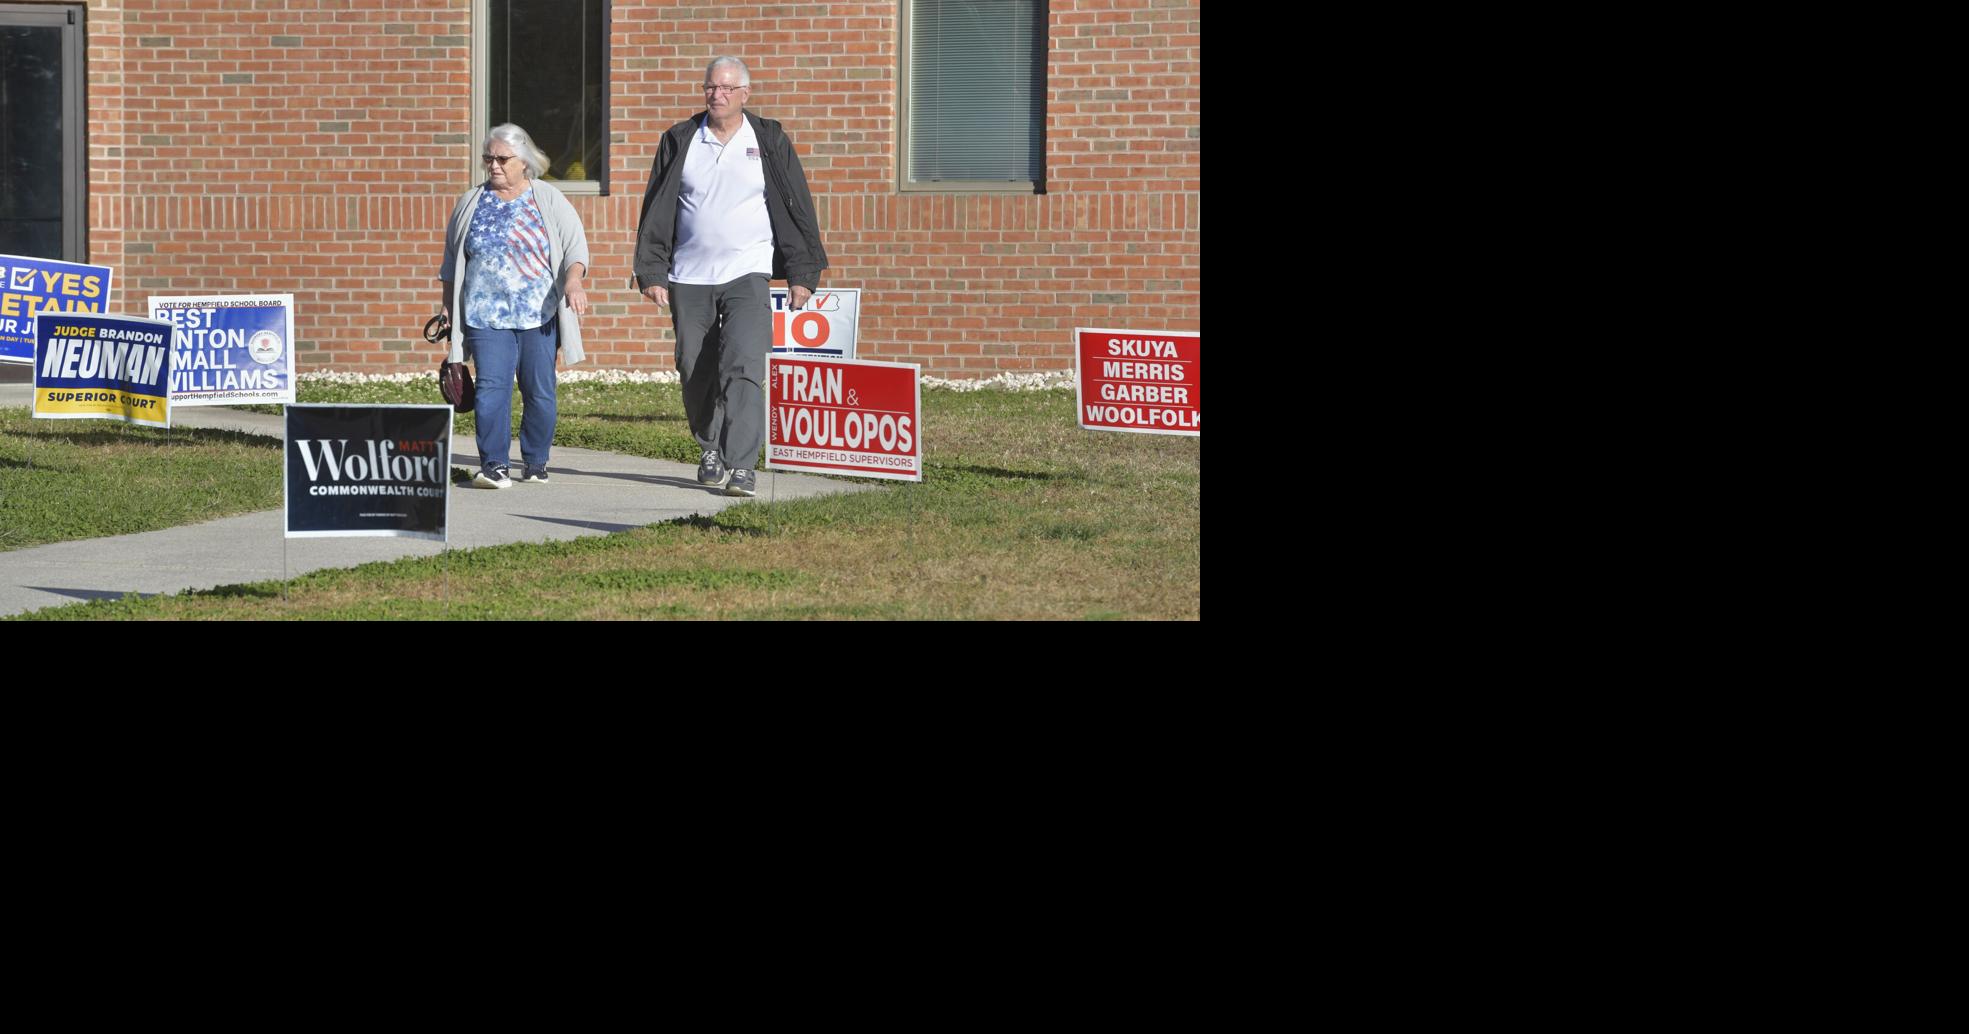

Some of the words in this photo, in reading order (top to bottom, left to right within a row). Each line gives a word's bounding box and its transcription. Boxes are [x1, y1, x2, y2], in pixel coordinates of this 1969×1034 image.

[41, 270, 100, 298] YES
[0, 292, 98, 318] ETAIN
[54, 326, 96, 337] JUDGE
[99, 328, 163, 344] BRANDON
[176, 329, 245, 350] NTON
[1108, 338, 1178, 358] SKUYA
[41, 338, 166, 386] NEUMAN
[171, 349, 237, 370] MALL
[1103, 361, 1185, 381] MERRIS
[171, 391, 278, 400] upportHempfieldSchools.com
[779, 365, 843, 405] TRAN
[847, 388, 859, 406] &
[1101, 383, 1188, 404] GARBER
[48, 392, 117, 402] SUPERIOR
[121, 395, 156, 409] COURT
[1086, 405, 1200, 427] WOOLFOLK
[779, 406, 912, 452] VOULOPOS
[399, 440, 433, 452] MATT
[295, 439, 444, 483] Wolford
[773, 447, 794, 458] EAST
[796, 449, 847, 462] HEMPFIELD
[849, 455, 913, 467] SUPERVISORS
[309, 485, 414, 496] COMMONWEALTH
